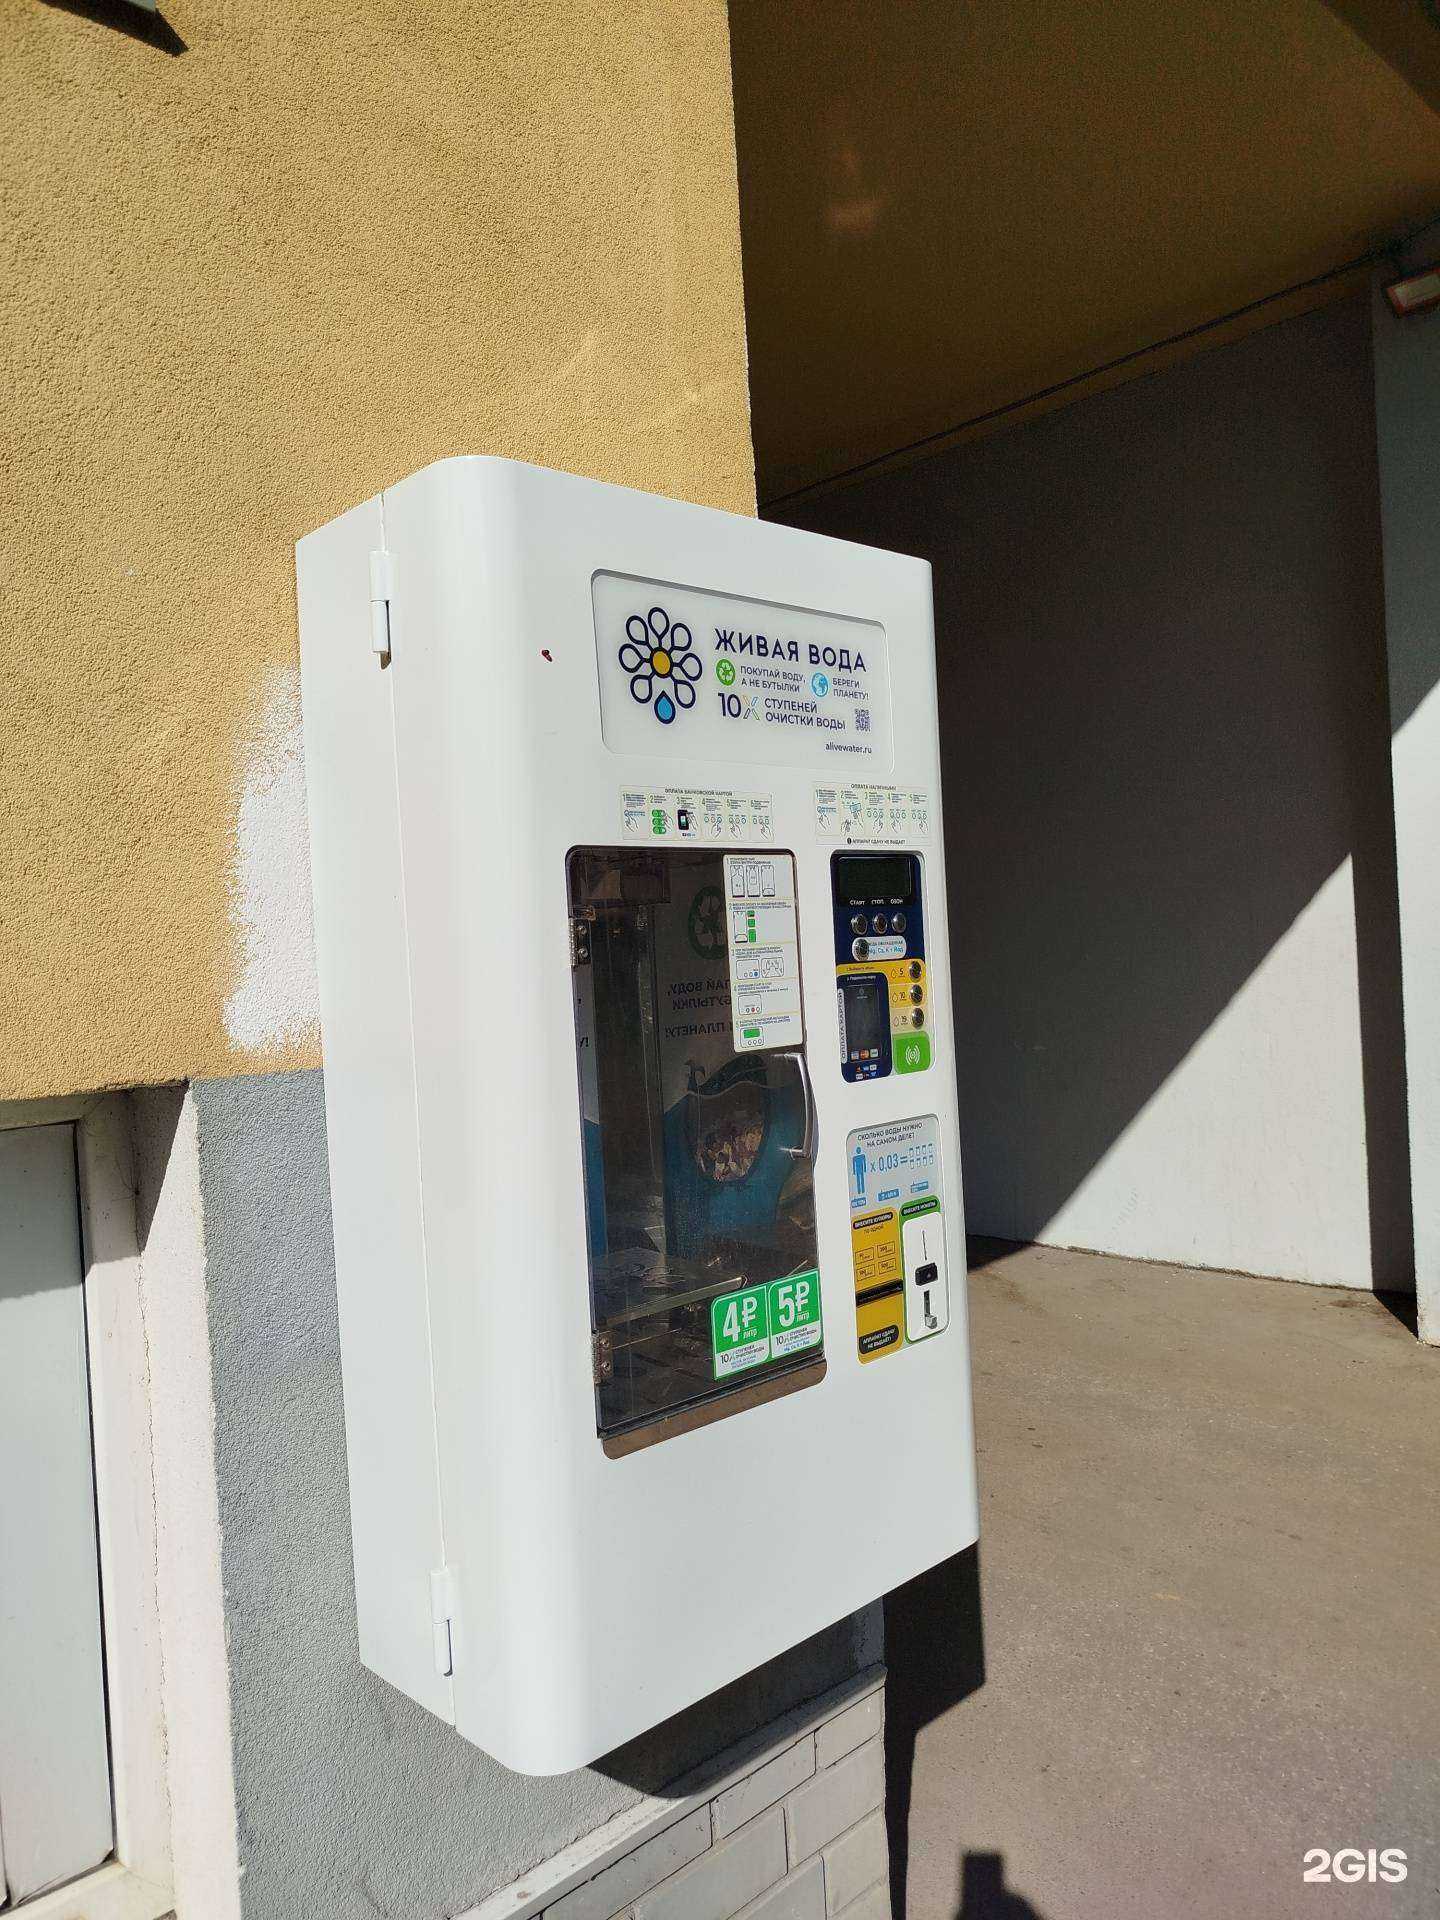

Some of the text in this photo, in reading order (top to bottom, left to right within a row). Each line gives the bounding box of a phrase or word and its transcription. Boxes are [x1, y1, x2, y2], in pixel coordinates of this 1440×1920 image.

[714, 628, 866, 672] ЖИВАЯ ВОДА
[740, 665, 806, 684] ПОКУПАЙ ВОДУ,
[742, 678, 800, 692] А НЕ БУТЫЛКИ
[832, 678, 860, 689] БЕРЕГИ
[833, 689, 869, 700] ПЛАНЕТУ!
[764, 697, 818, 713] СТУПЕНЕЙ
[765, 711, 846, 730] ОЧИСТКИ ВОДЫ
[825, 742, 872, 754] alivewater.ru
[858, 1122, 922, 1141] СКОЛЬКО ВОДЫ НУЖНО
[876, 1137, 897, 1145] САМОМ
